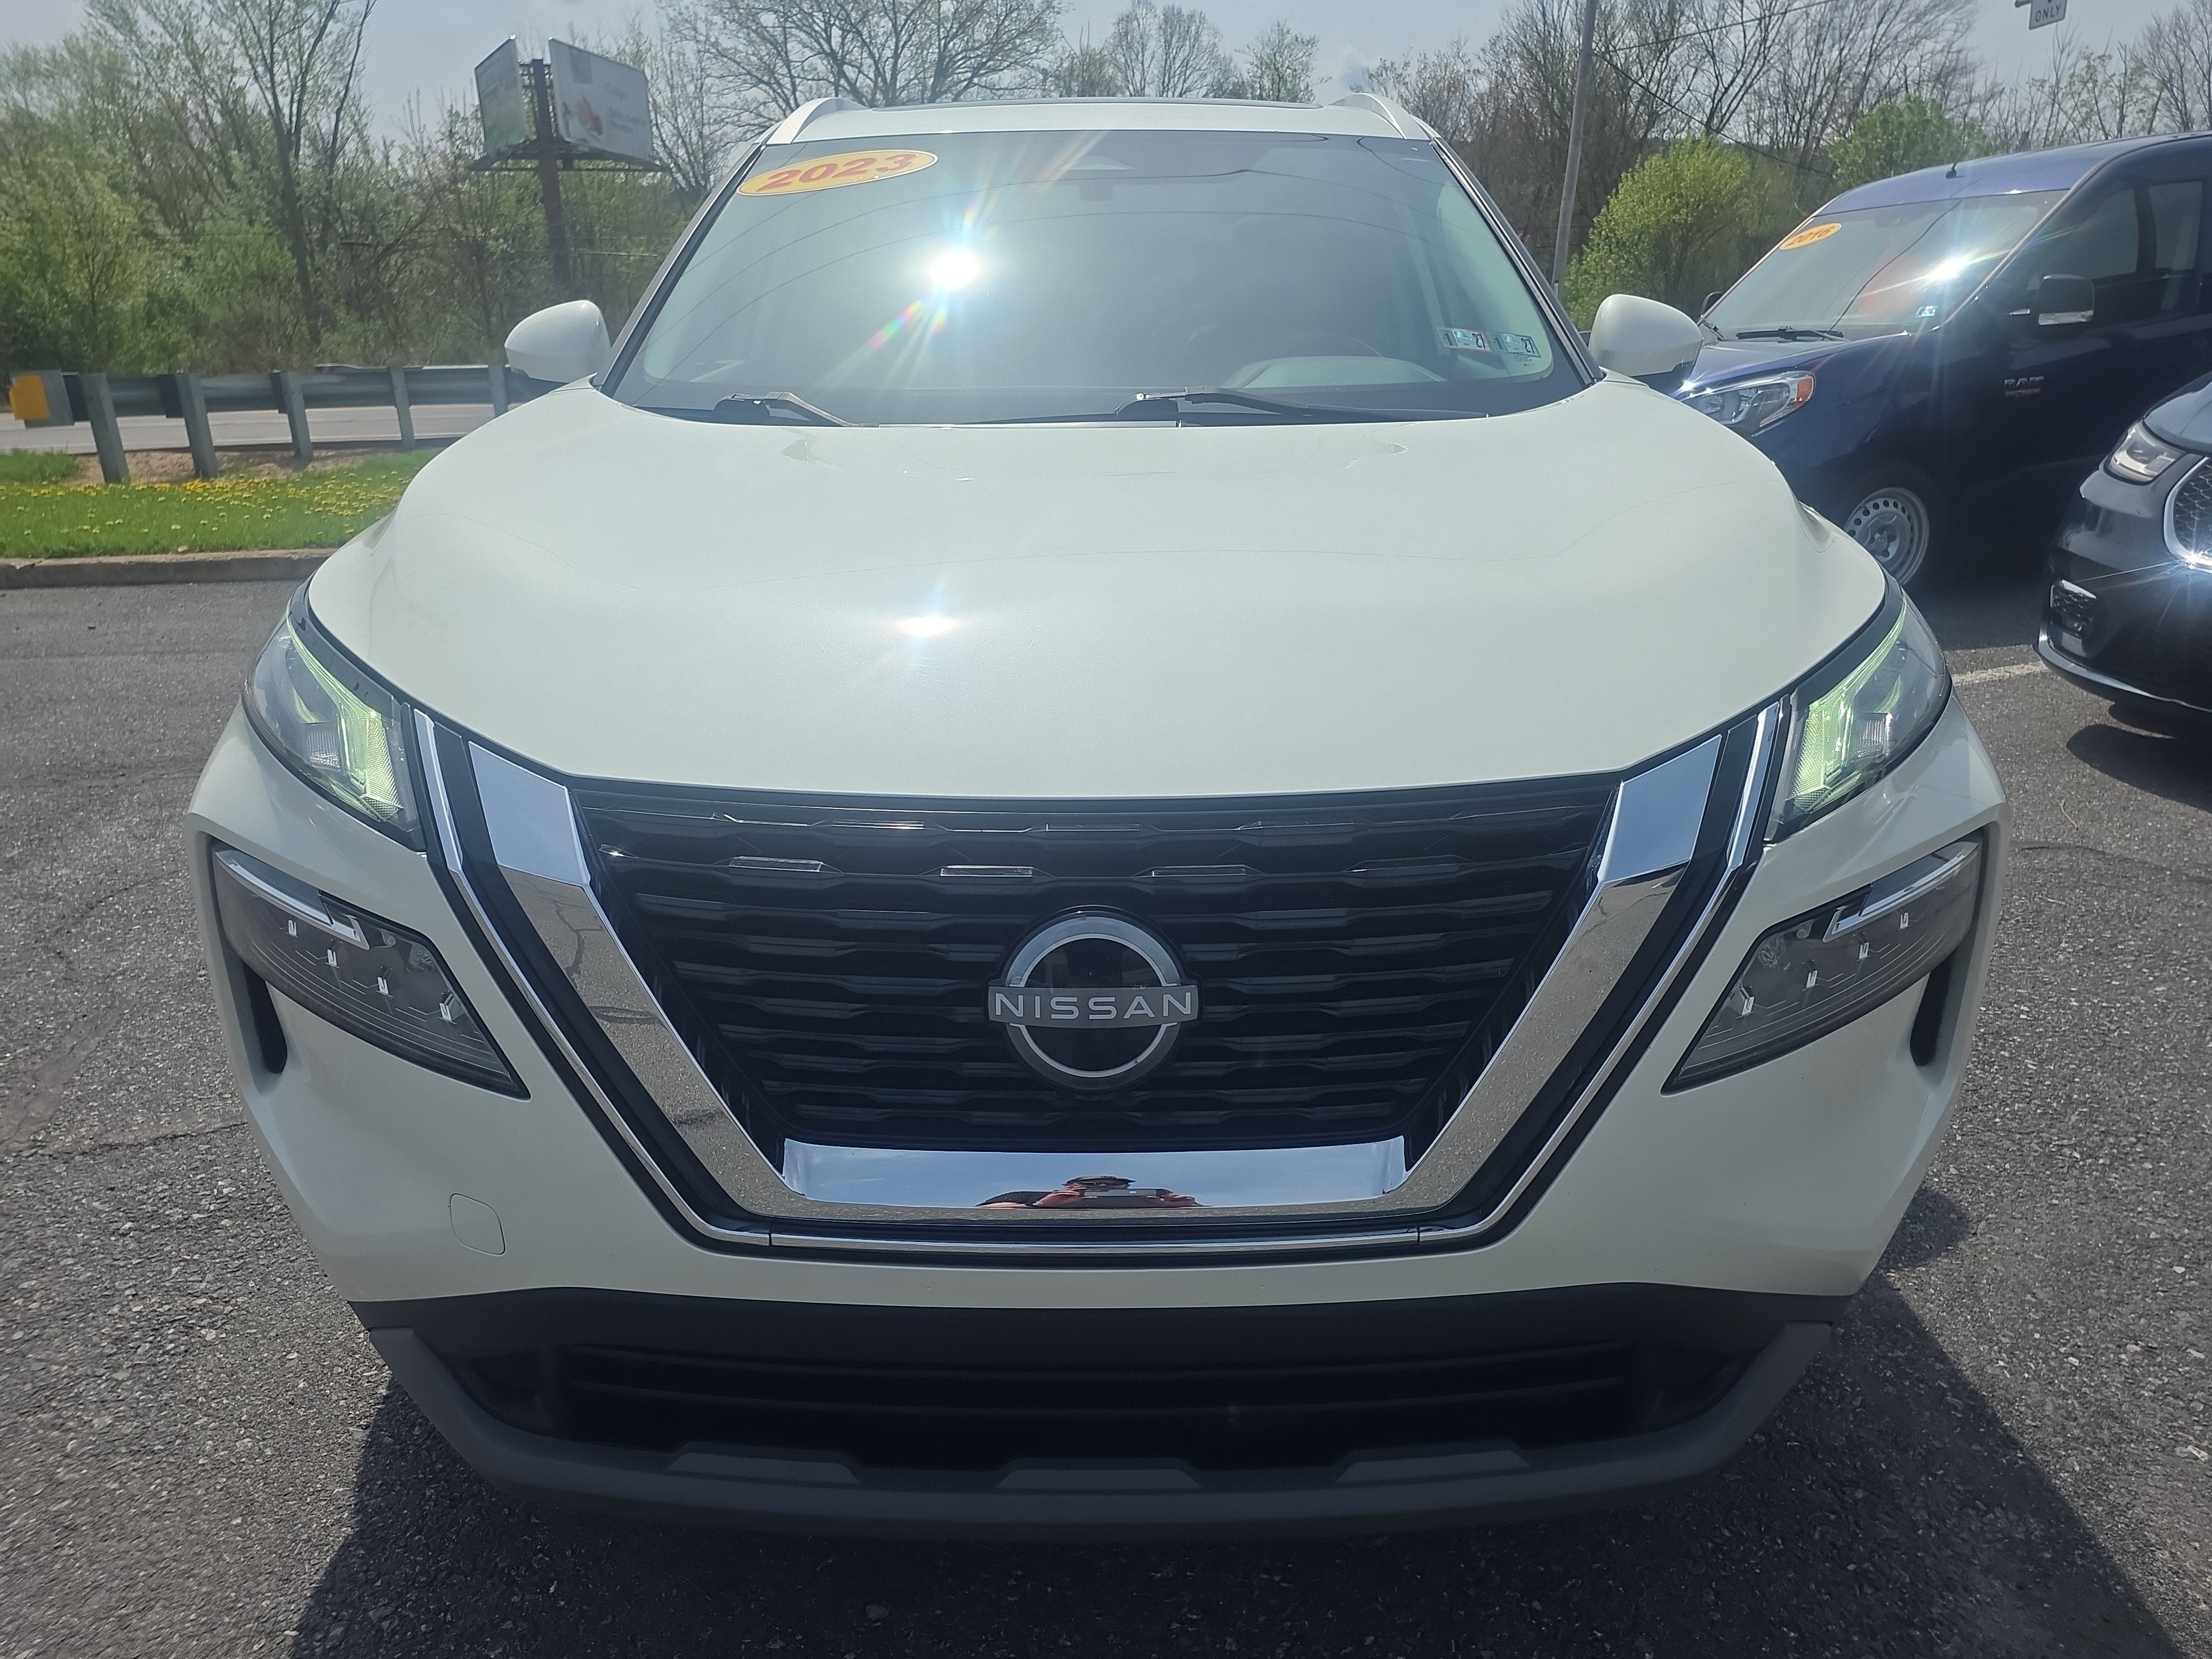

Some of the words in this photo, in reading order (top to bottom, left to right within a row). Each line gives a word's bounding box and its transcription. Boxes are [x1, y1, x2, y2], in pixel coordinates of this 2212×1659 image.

[2035, 4, 2061, 22] ONLY
[756, 153, 917, 192] 2023
[1443, 332, 1454, 346] 1
[1471, 332, 1486, 350] 27
[1494, 337, 1503, 351] 1
[1520, 338, 1535, 354] 27
[995, 992, 1191, 1020] NISSAN
